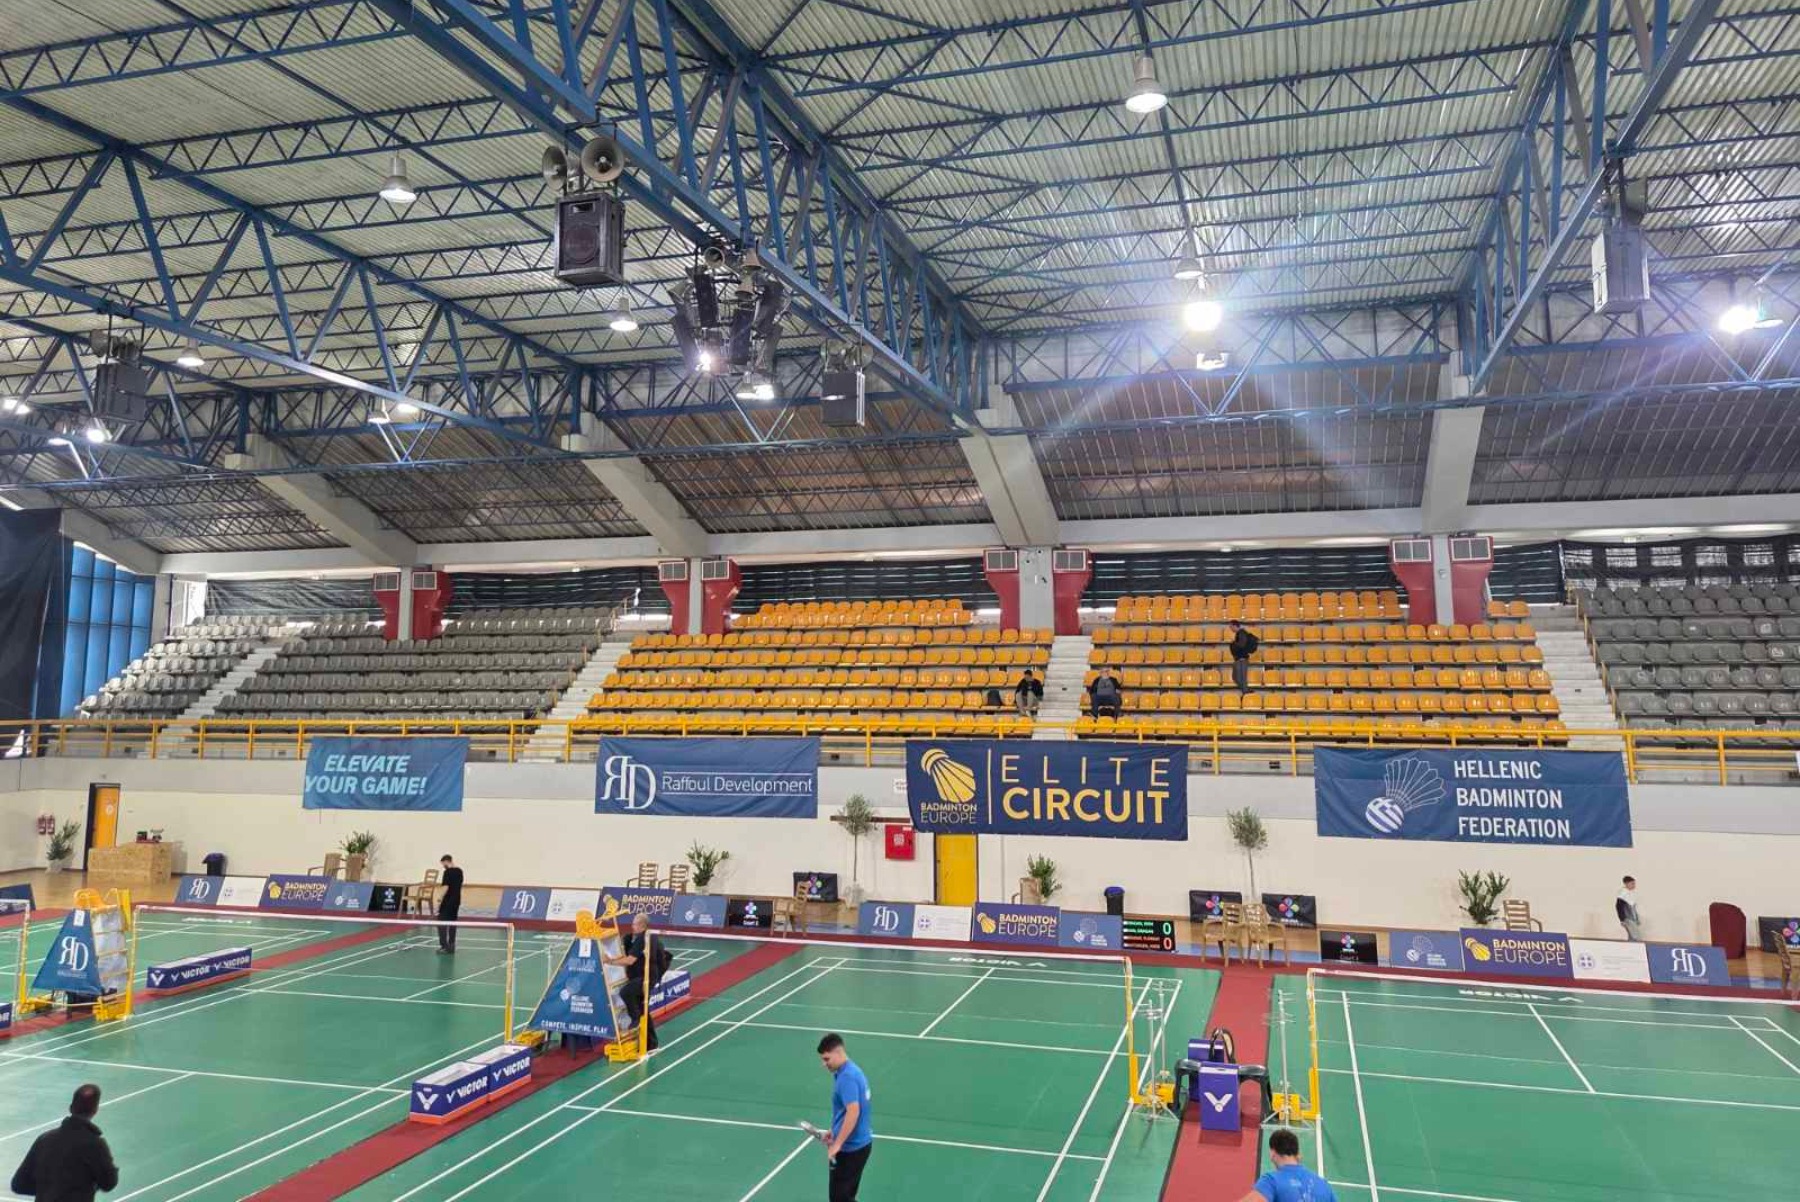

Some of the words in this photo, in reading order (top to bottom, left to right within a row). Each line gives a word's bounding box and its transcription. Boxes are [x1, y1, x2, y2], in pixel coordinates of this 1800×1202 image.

[324, 754, 411, 773] ELEVATE
[1454, 760, 1542, 779] HELLENIC
[1002, 755, 1169, 787] ELITE
[305, 775, 358, 794] YOUR
[362, 776, 428, 795] GAME!
[662, 776, 710, 791] Raffoul
[714, 776, 813, 795] Development
[1002, 787, 1169, 824] CIRCUIT
[1456, 788, 1562, 809] BADMINTON
[921, 802, 977, 813] BADMINTON
[921, 812, 977, 825] EUROPE
[1458, 817, 1571, 839] FEDERATION
[285, 881, 327, 891] BADMINTON
[281, 890, 324, 901] EUROPE
[622, 894, 672, 904] BADMINTON
[621, 902, 670, 916] EUROPE
[999, 913, 1057, 925] BADMINTON
[998, 923, 1057, 938] EUROPE
[1162, 922, 1172, 935] 0
[1163, 937, 1172, 950] 0
[1492, 938, 1566, 952] BADMINTON
[224, 956, 250, 968] VICTOR
[1493, 949, 1567, 966] EUROPE
[181, 966, 210, 979] VICTOR
[503, 1056, 531, 1077] VICTOR
[457, 1075, 488, 1098] VICTOR
